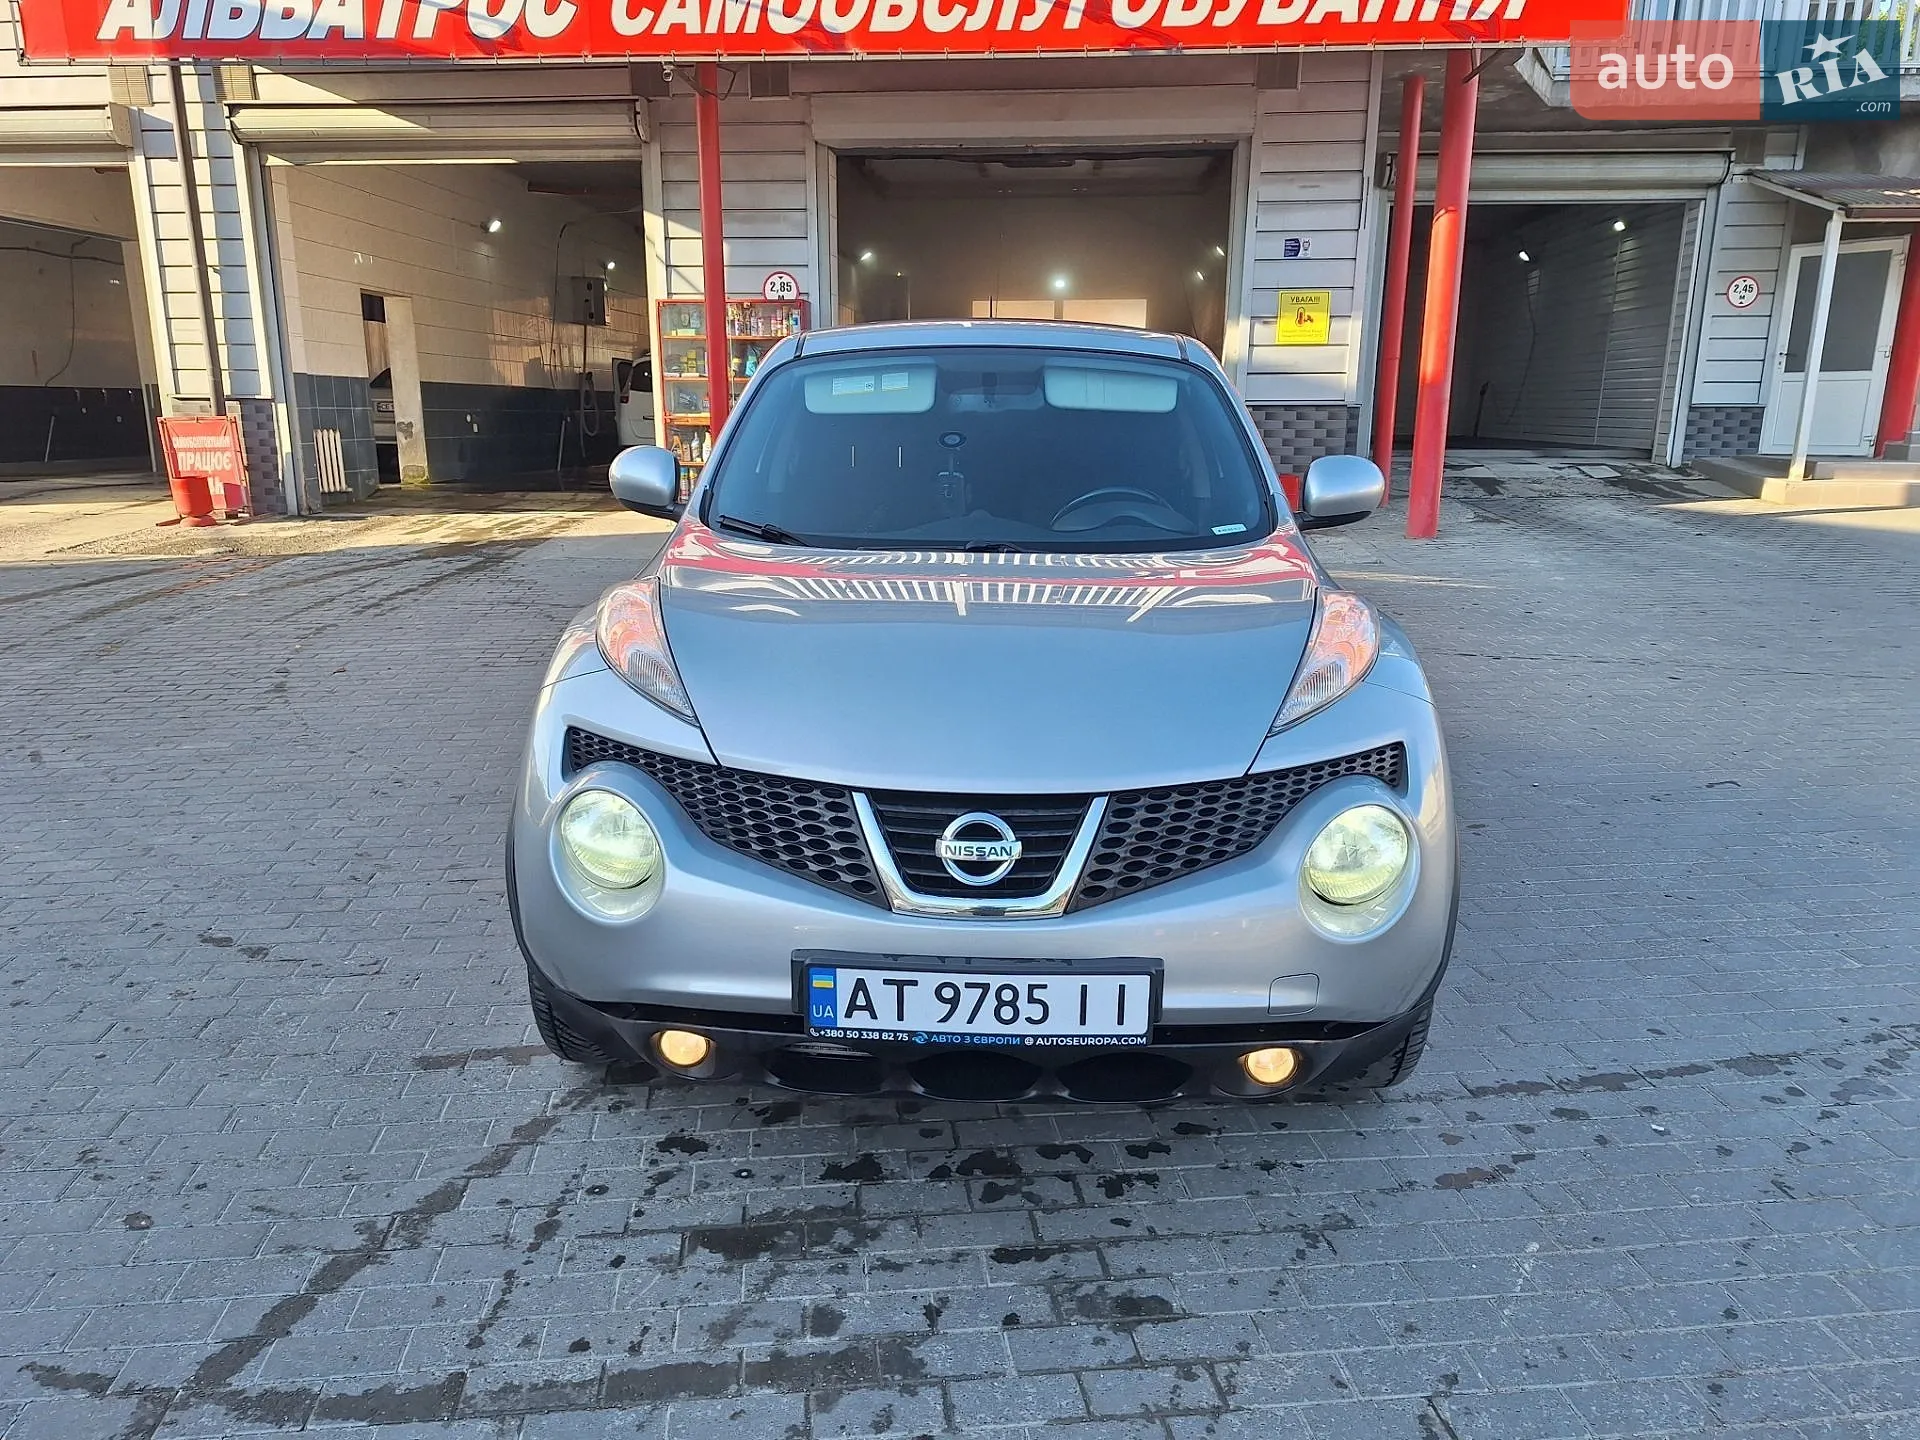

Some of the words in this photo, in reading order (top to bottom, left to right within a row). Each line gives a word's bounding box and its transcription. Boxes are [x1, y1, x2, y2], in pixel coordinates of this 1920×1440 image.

[770, 281, 792, 293] 2,85
[1733, 284, 1754, 294] 2,45
[177, 451, 232, 473] ПРАЦЮЄ
[944, 845, 1012, 857] NISSAN
[844, 978, 918, 1021] AT
[934, 982, 1049, 1025] 9785
[812, 1004, 834, 1018] UA
[820, 1029, 844, 1038] +380
[846, 1030, 859, 1039] 50
[861, 1031, 879, 1040] 338
[882, 1032, 894, 1041] 82
[896, 1033, 909, 1041] 75
[931, 1034, 961, 1043] АВТО
[974, 1036, 1020, 1045] ЄВРОПИ
[1036, 1037, 1147, 1046] AUTOSEUROPA.COM
